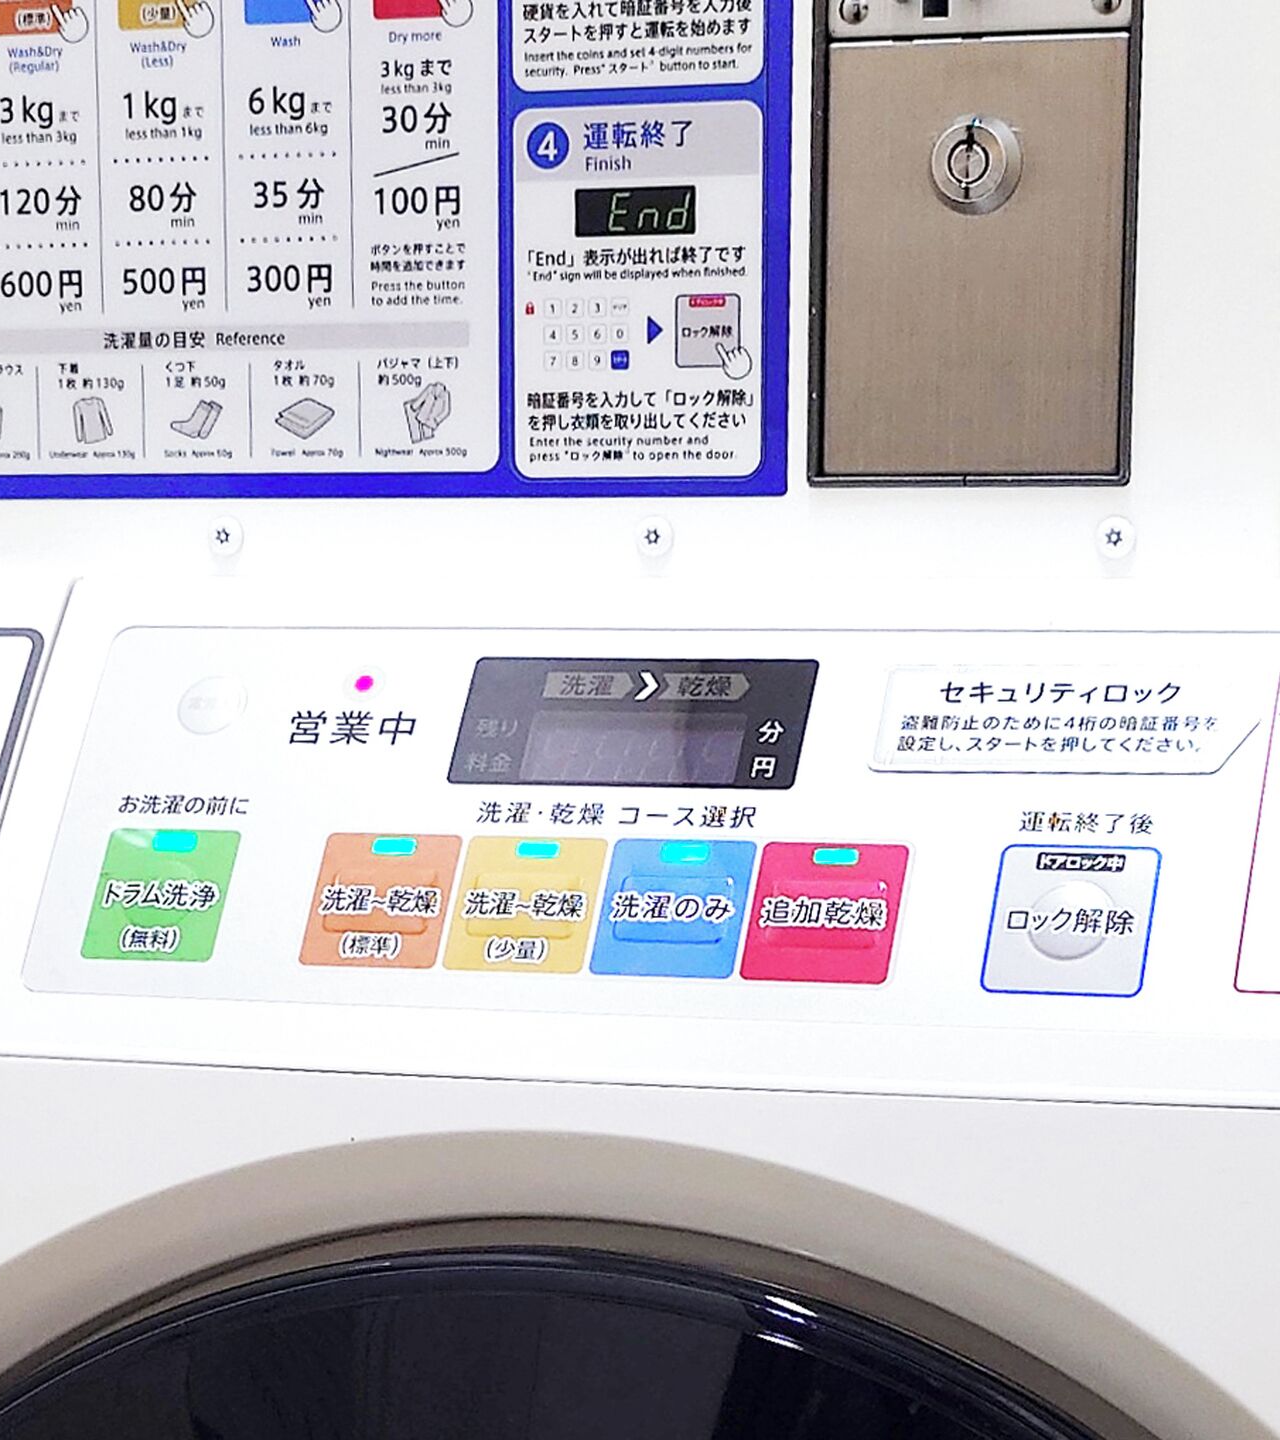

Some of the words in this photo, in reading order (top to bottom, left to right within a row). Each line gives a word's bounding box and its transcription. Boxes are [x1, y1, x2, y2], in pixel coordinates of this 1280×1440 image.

[388, 31, 408, 45] Dry
[412, 31, 442, 42] more
[524, 18, 751, 43] スタートを押すと運転を始めます
[7, 46, 63, 59] Wash&Dry
[129, 41, 187, 54] Wash&Dry
[271, 36, 301, 48] Wash
[425, 137, 451, 150] min
[537, 130, 558, 161] 4
[584, 120, 693, 150] 運転終了
[585, 156, 631, 172] Finish
[298, 213, 324, 226] min
[607, 191, 691, 232] End
[56, 219, 81, 232] min
[171, 216, 195, 229] min
[436, 217, 461, 232] yen
[59, 301, 82, 315] yen
[182, 299, 205, 312] yen
[308, 296, 331, 310] yen
[104, 331, 205, 350] 洗濯量の目安
[216, 332, 286, 347] Reference
[527, 411, 747, 431] を押し衣類を取り出してください
[559, 674, 615, 697] 洗濯
[677, 674, 732, 697] 乾燥
[940, 681, 1182, 704] セキュリティロック
[289, 710, 417, 746] 営業中
[757, 719, 785, 743] 分
[750, 756, 777, 779] 円
[118, 795, 250, 816] お洗濯の前に
[618, 805, 758, 829] コース選択
[1019, 811, 1154, 835] 運転終了後
[1039, 853, 1125, 872] ドアロック中
[104, 882, 217, 909] ドラム洗浄
[613, 894, 732, 921] 洗濯のみ
[762, 899, 884, 927] 追加乾燥
[1007, 908, 1136, 935] ロック解除
